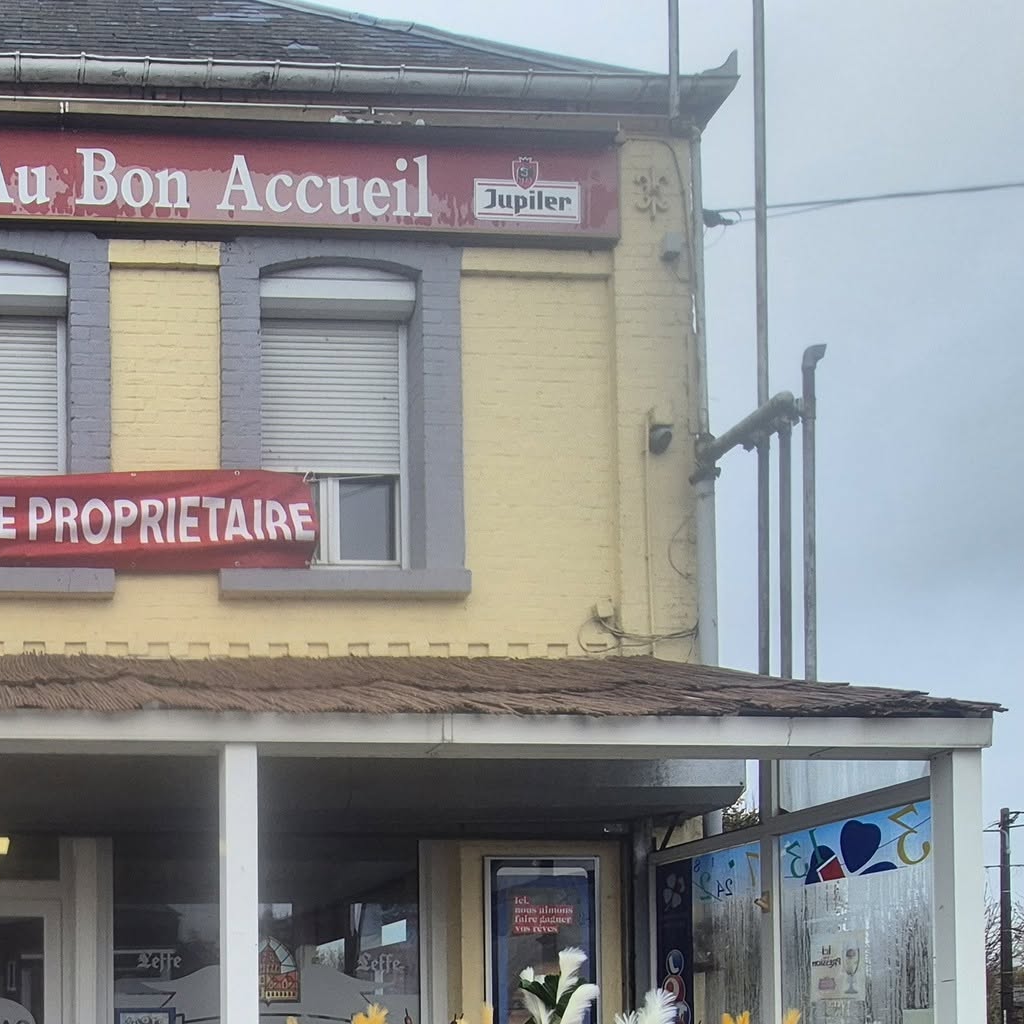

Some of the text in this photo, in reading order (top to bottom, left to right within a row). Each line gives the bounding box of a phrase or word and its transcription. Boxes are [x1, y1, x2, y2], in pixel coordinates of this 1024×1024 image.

[75, 147, 191, 210] Bon
[216, 154, 433, 218] Accueil
[482, 187, 573, 216] Jupiler
[28, 495, 316, 545] PROPRIETAIRE
[515, 915, 572, 923] faire gagner
[539, 905, 573, 914] aimons
